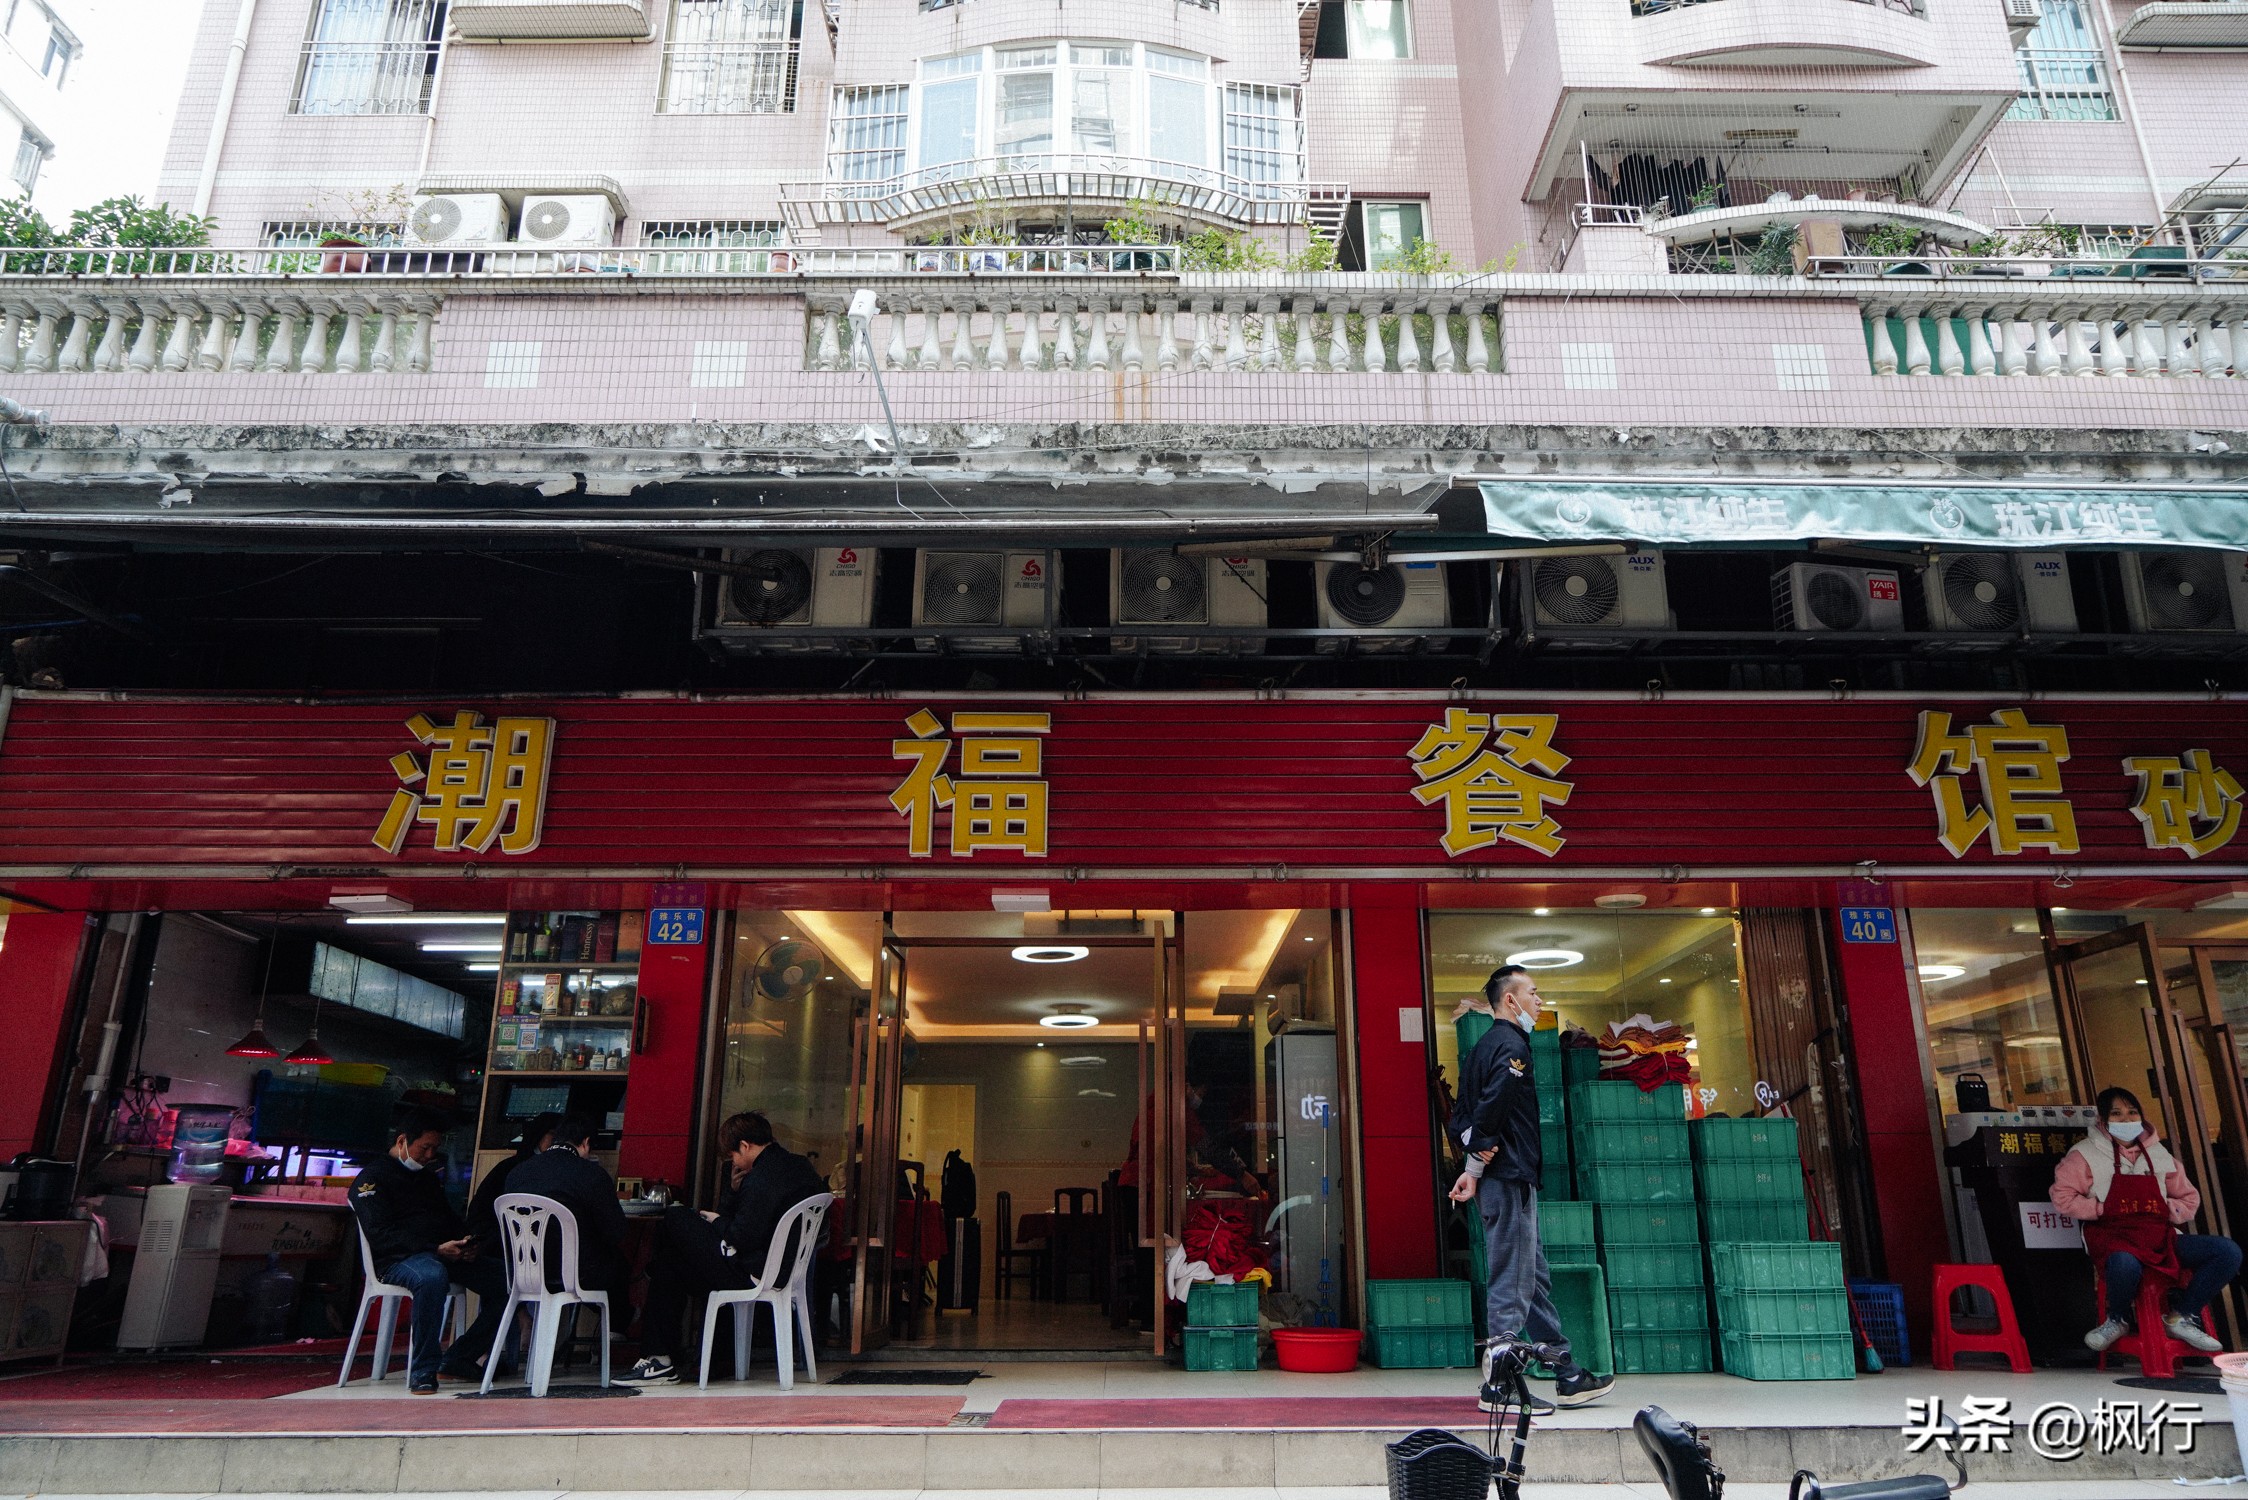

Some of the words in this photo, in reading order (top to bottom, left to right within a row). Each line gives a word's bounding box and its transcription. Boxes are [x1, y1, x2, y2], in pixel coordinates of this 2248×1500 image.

[1620, 494, 1790, 532] 珠江纯生
[1992, 500, 2163, 538] 珠江纯生
[1628, 556, 1655, 564] AUX
[2034, 561, 2061, 570] AUX
[1871, 580, 1895, 590] YAIR
[2121, 749, 2245, 859] 砂
[659, 911, 697, 921] 雅乐街
[1848, 910, 1885, 920] 雅乐街
[657, 922, 684, 941] 42
[1851, 921, 1877, 940] 40
[581, 922, 596, 960] Hennessy
[2026, 1211, 2074, 1229] 可打包
